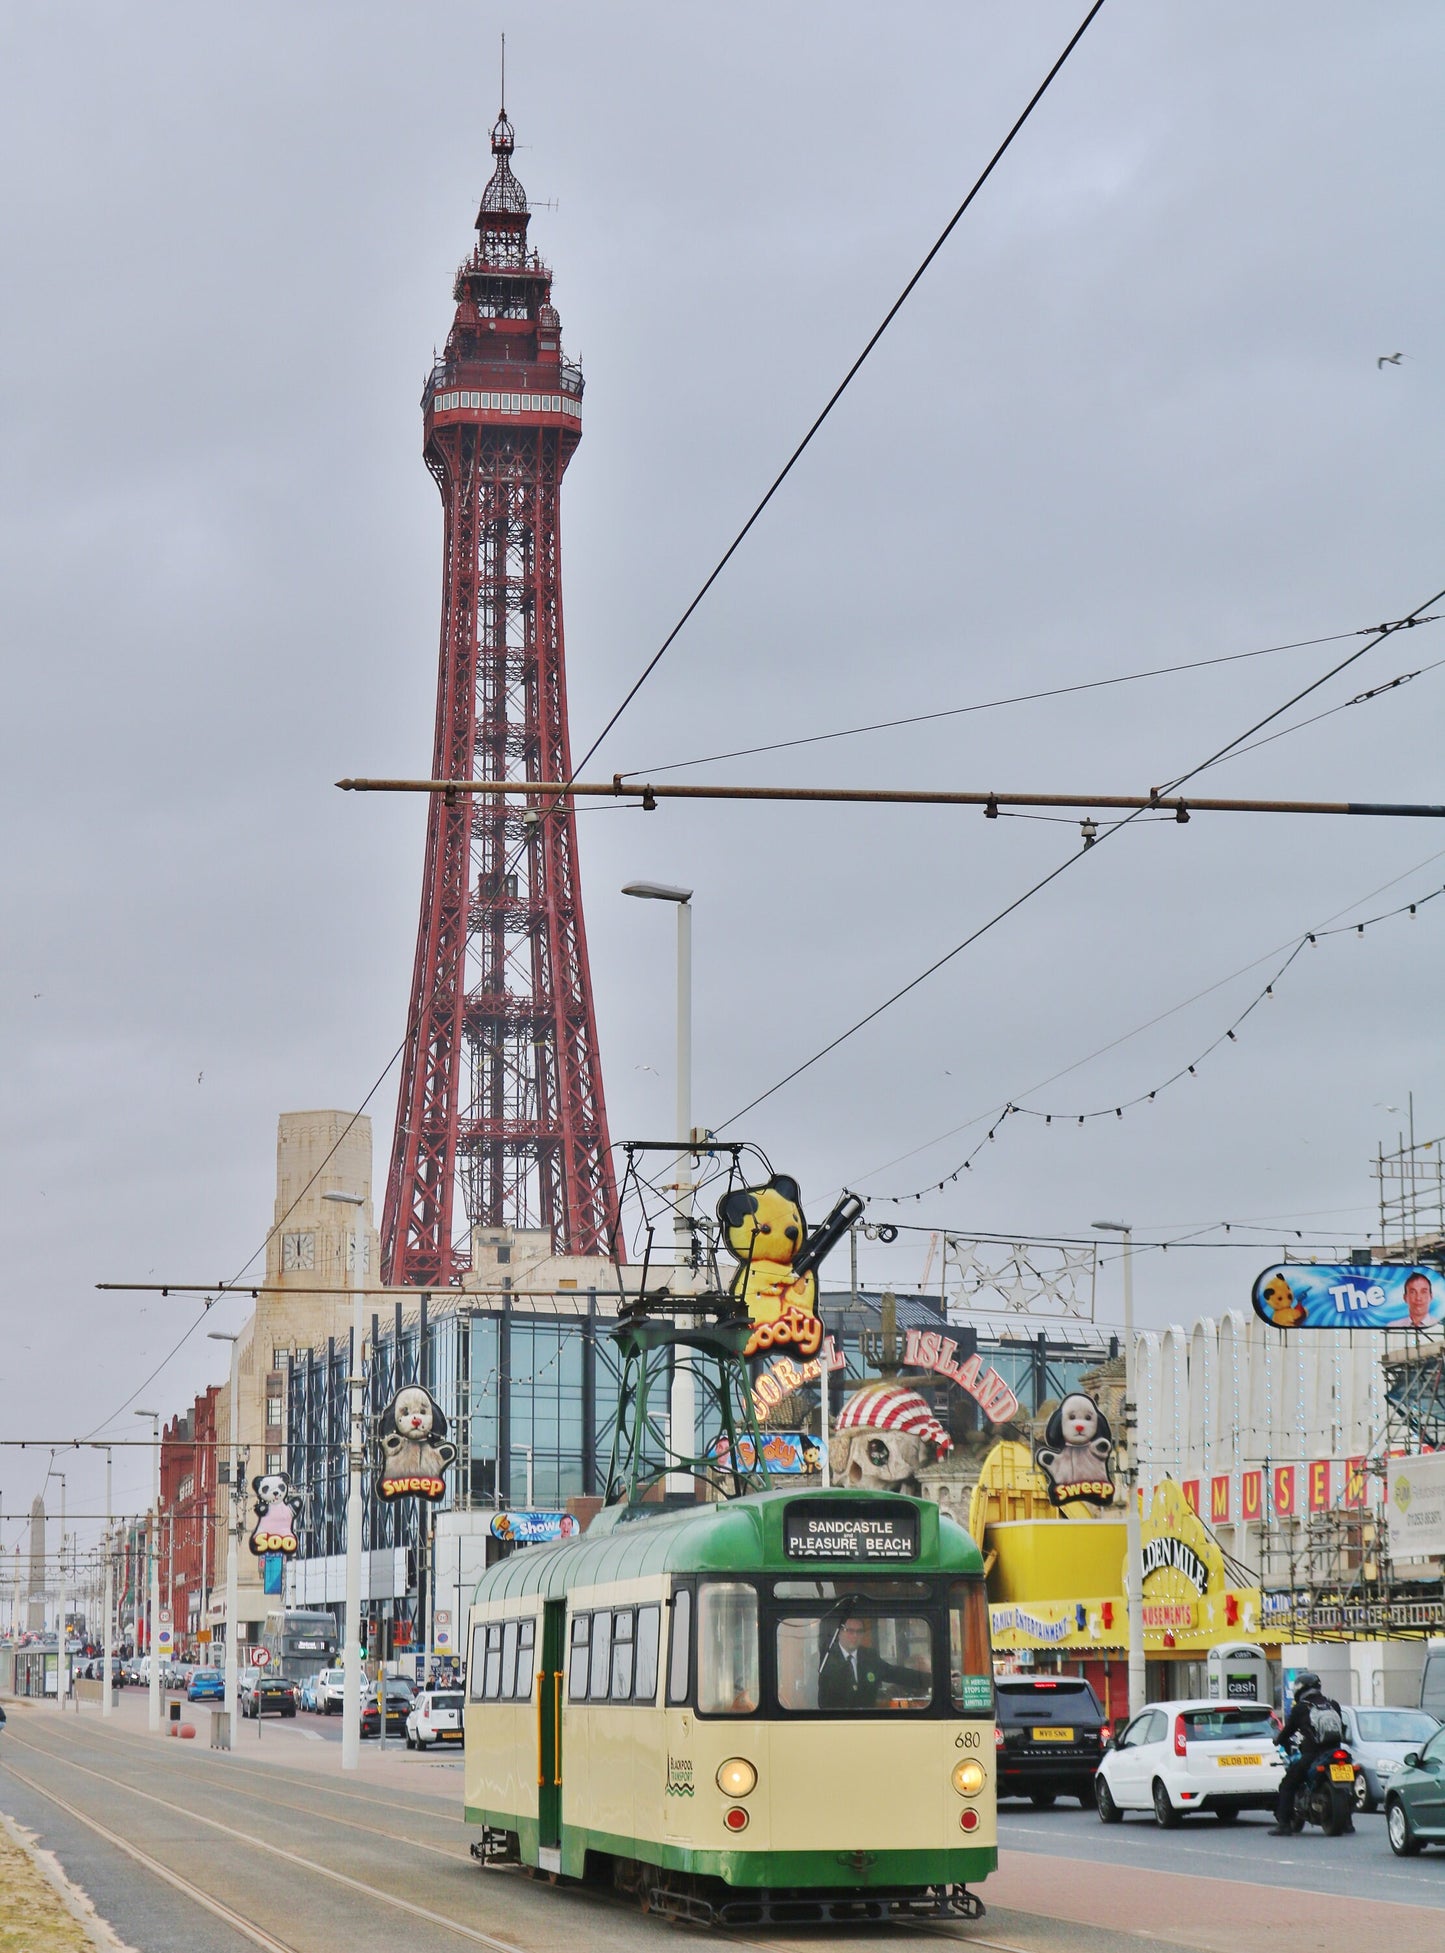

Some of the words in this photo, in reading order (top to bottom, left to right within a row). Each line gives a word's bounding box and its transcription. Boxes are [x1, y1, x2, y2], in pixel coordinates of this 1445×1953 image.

[1328, 1283, 1386, 1313] The
[903, 1328, 1019, 1424] ISLAND
[738, 1436, 796, 1467] Soty
[519, 1520, 556, 1535] Show
[808, 1521, 893, 1533] SANDCASTLE
[790, 1537, 858, 1549] PLEASURE
[865, 1539, 911, 1550] BEACH
[1141, 1538, 1171, 1579] LDEN
[1171, 1538, 1205, 1596] MILE
[1142, 1605, 1191, 1626] MUSEMENTS
[1234, 1650, 1252, 1658] cash
[1228, 1681, 1256, 1693] cash
[954, 1731, 981, 1749] 680
